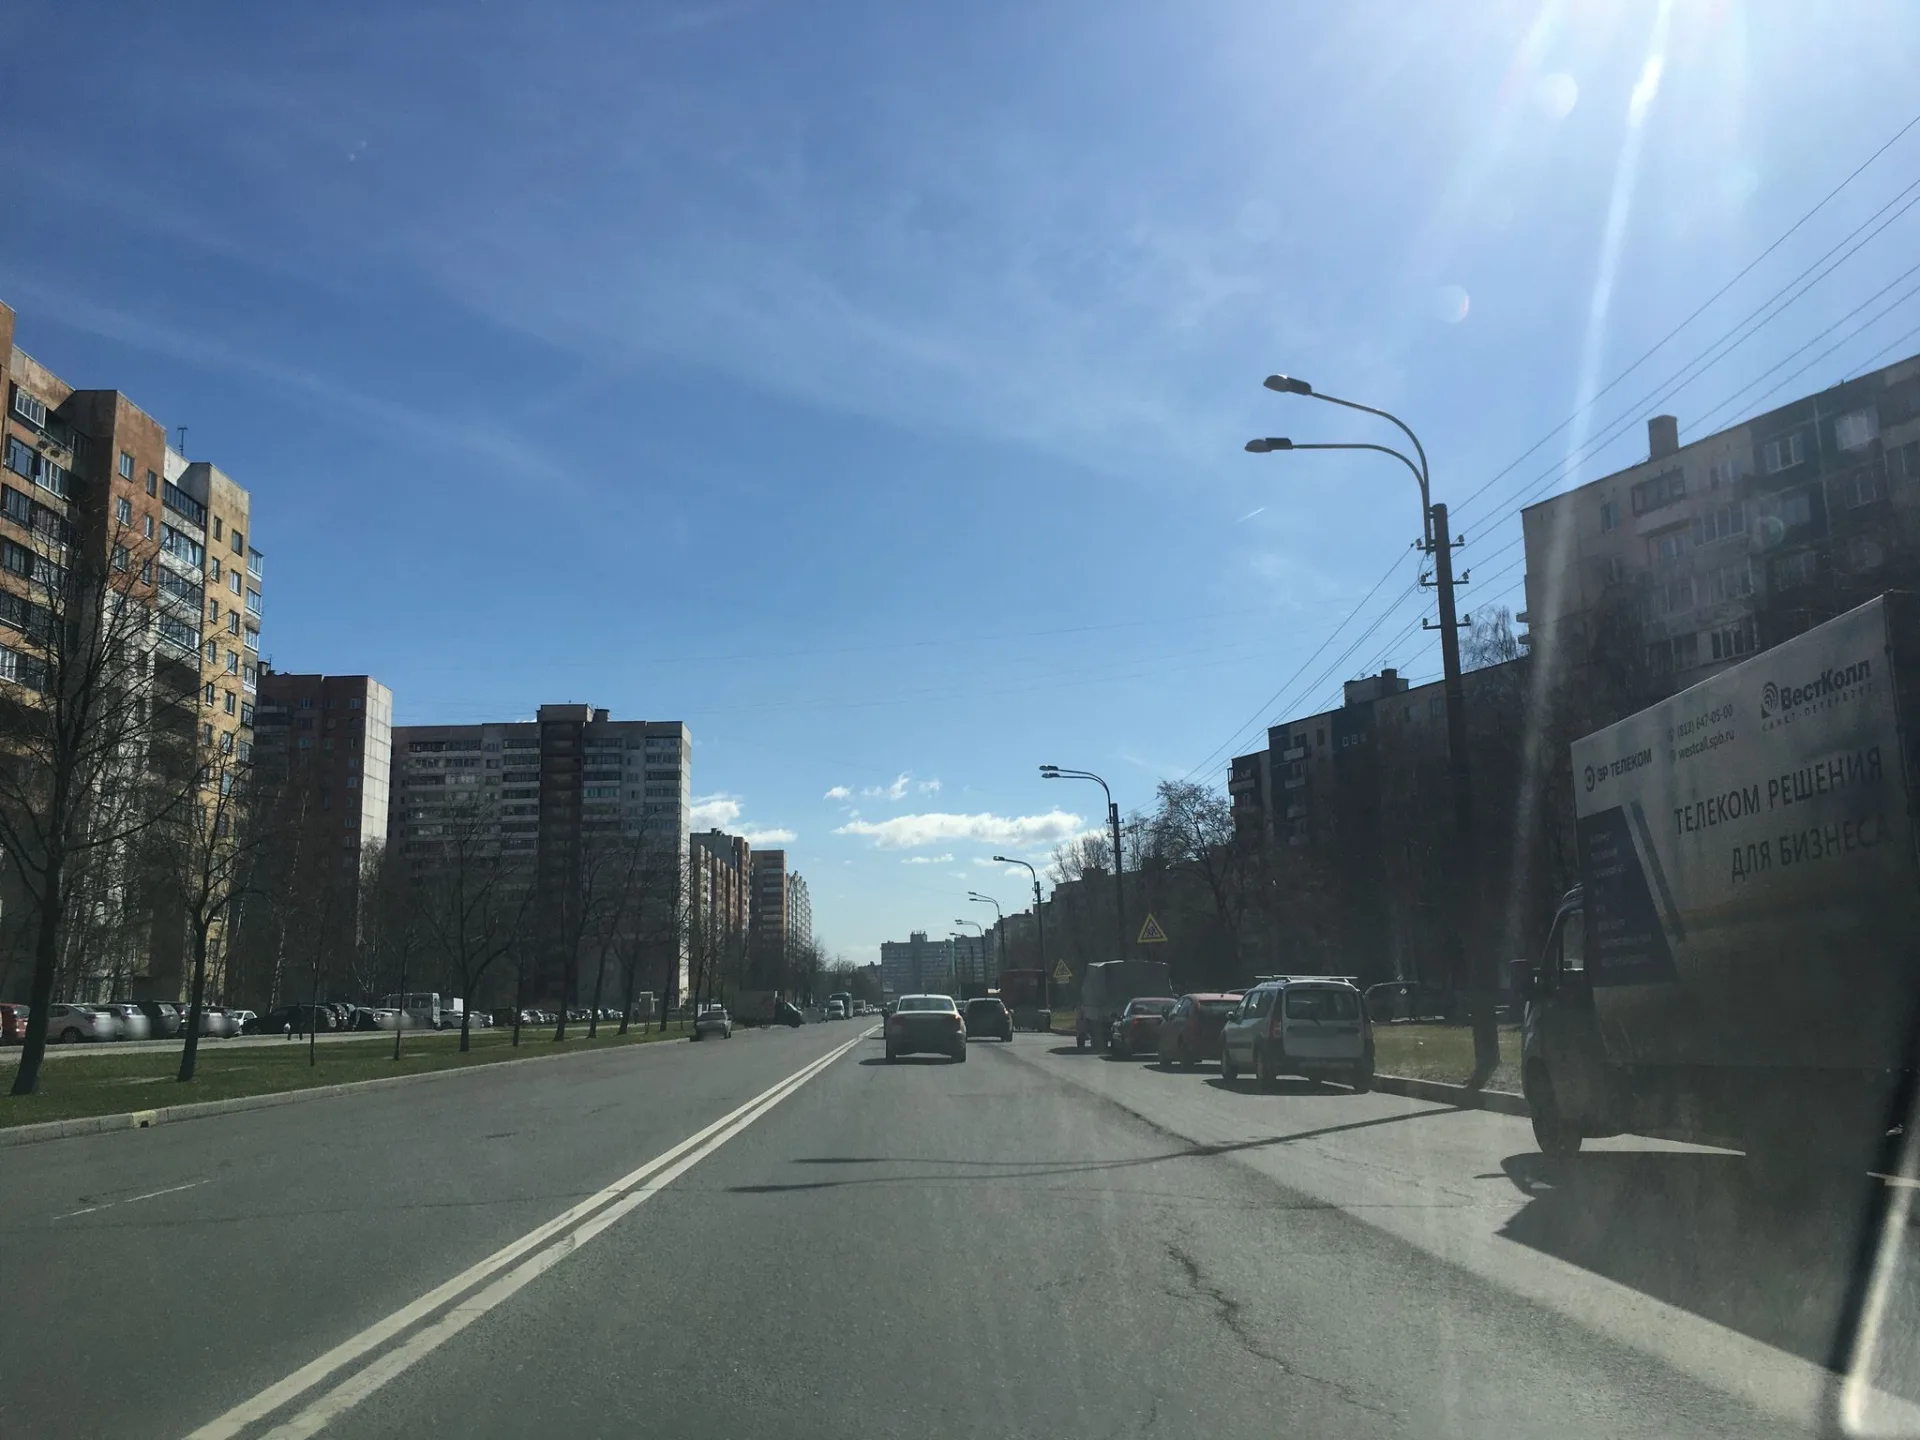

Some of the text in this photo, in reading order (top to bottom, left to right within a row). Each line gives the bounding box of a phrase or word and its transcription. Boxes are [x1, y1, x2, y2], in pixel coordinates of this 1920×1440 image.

[1781, 659, 1871, 711] ВестКолл
[1610, 748, 1652, 777] ТЕЛЕКОМ
[1678, 730, 1735, 760] westcall.spb.ru
[1674, 745, 1884, 835] ТЕЛЕКОМ РЕШЕНИЯ
[1732, 812, 1893, 883] ДЛЯ БИЗНЕСА
